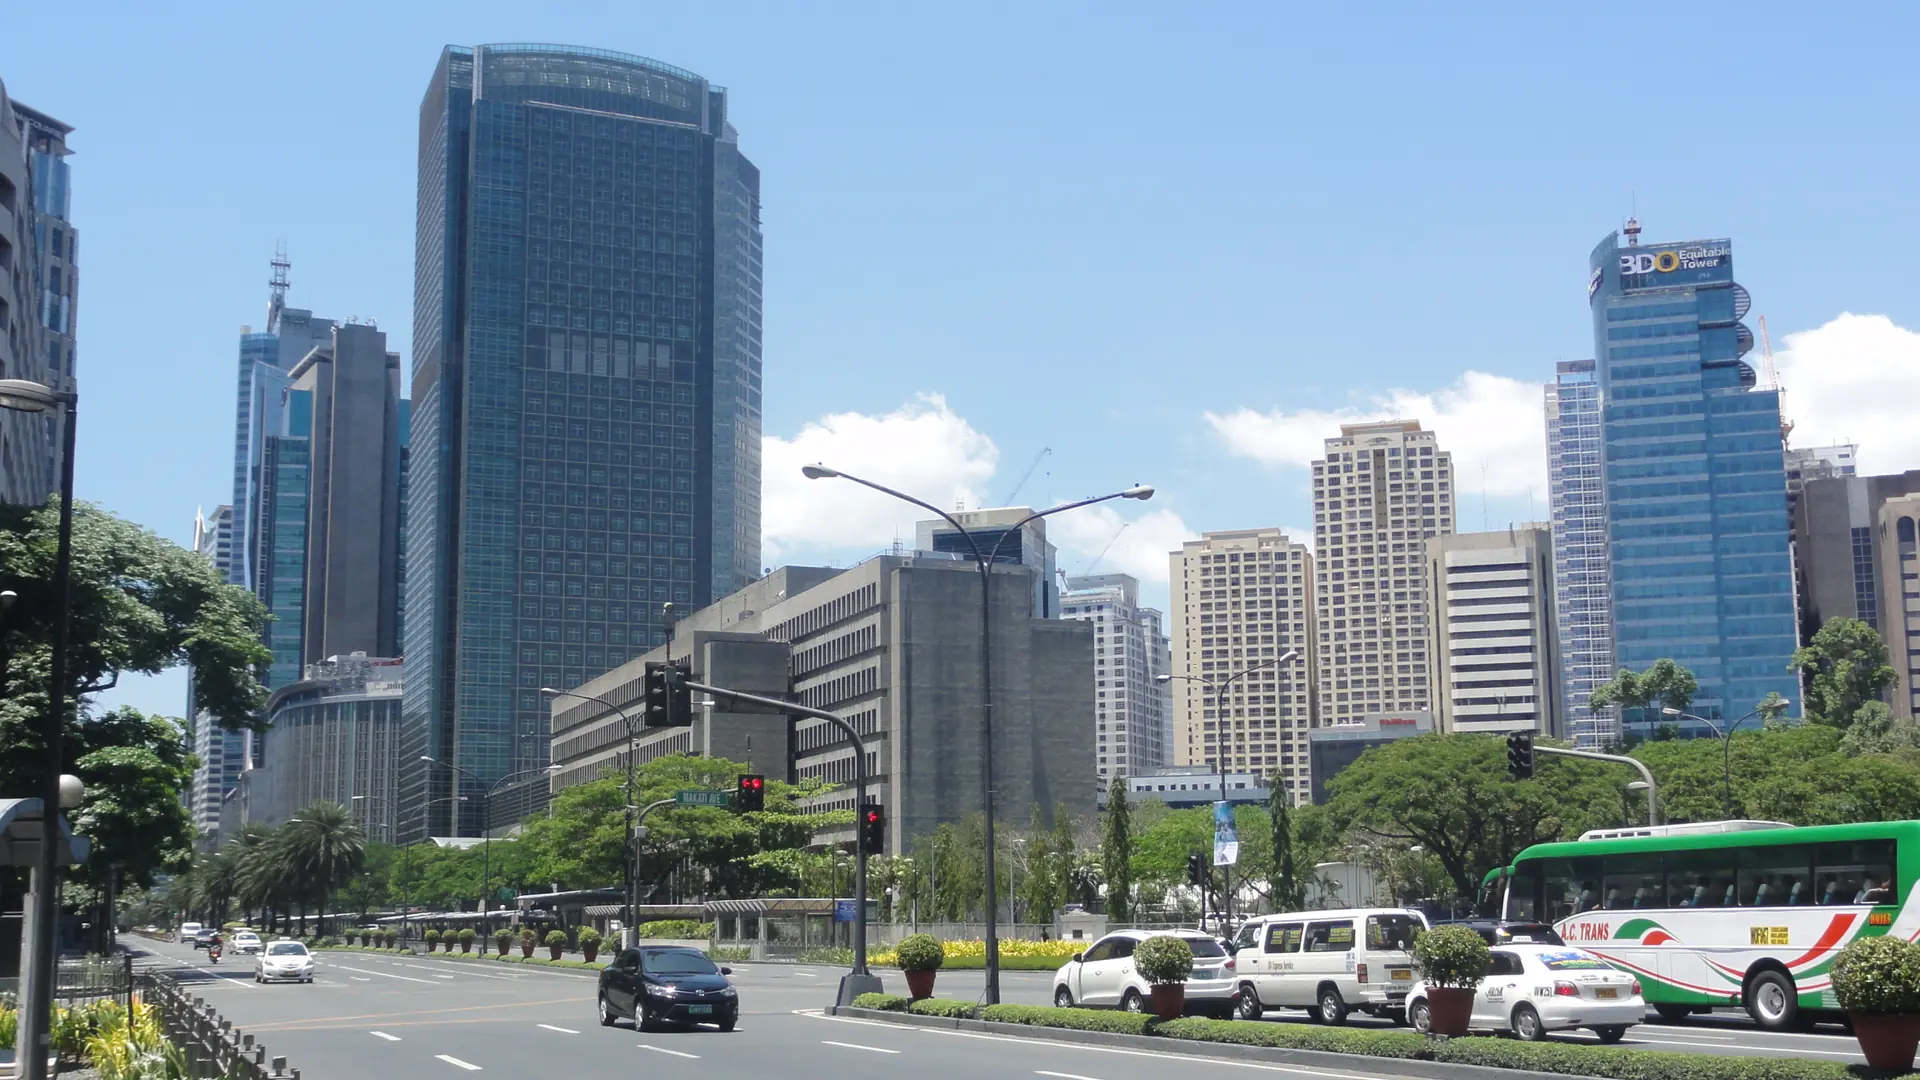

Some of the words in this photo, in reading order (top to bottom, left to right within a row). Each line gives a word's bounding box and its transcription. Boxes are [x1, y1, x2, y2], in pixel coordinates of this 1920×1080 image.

[1679, 247, 1731, 260] Equitable
[1619, 250, 1680, 275] BDO
[1682, 259, 1719, 270] Tower
[684, 792, 707, 804] MAKATI
[1561, 923, 1577, 941] A.C.
[1580, 922, 1609, 941] TRANS
